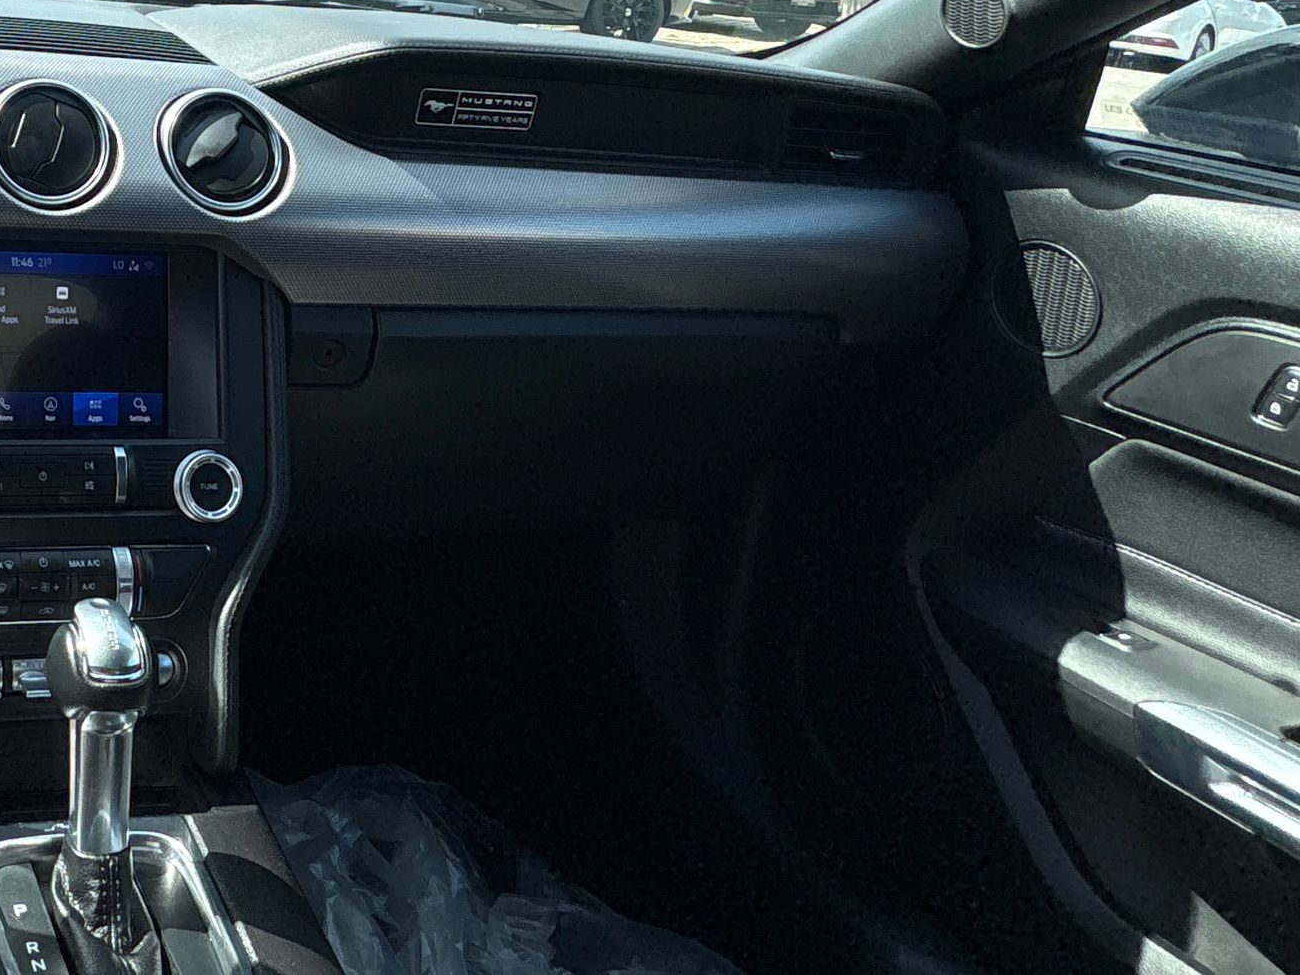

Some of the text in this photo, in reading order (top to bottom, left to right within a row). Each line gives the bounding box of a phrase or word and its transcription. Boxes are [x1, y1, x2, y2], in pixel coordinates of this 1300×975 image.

[461, 96, 533, 108] MUSTANG
[10, 256, 34, 268] 11:46
[113, 259, 125, 271] LO
[47, 305, 77, 315] SiriusXM
[1, 315, 19, 326] Apps
[44, 315, 79, 325] Travel Link
[88, 414, 103, 424] Apps
[200, 482, 221, 491] TUNE
[68, 558, 101, 569] MAX A/C
[81, 582, 97, 592] A/C
[12, 903, 28, 918] P
[25, 940, 41, 955] R
[30, 958, 47, 973] N
